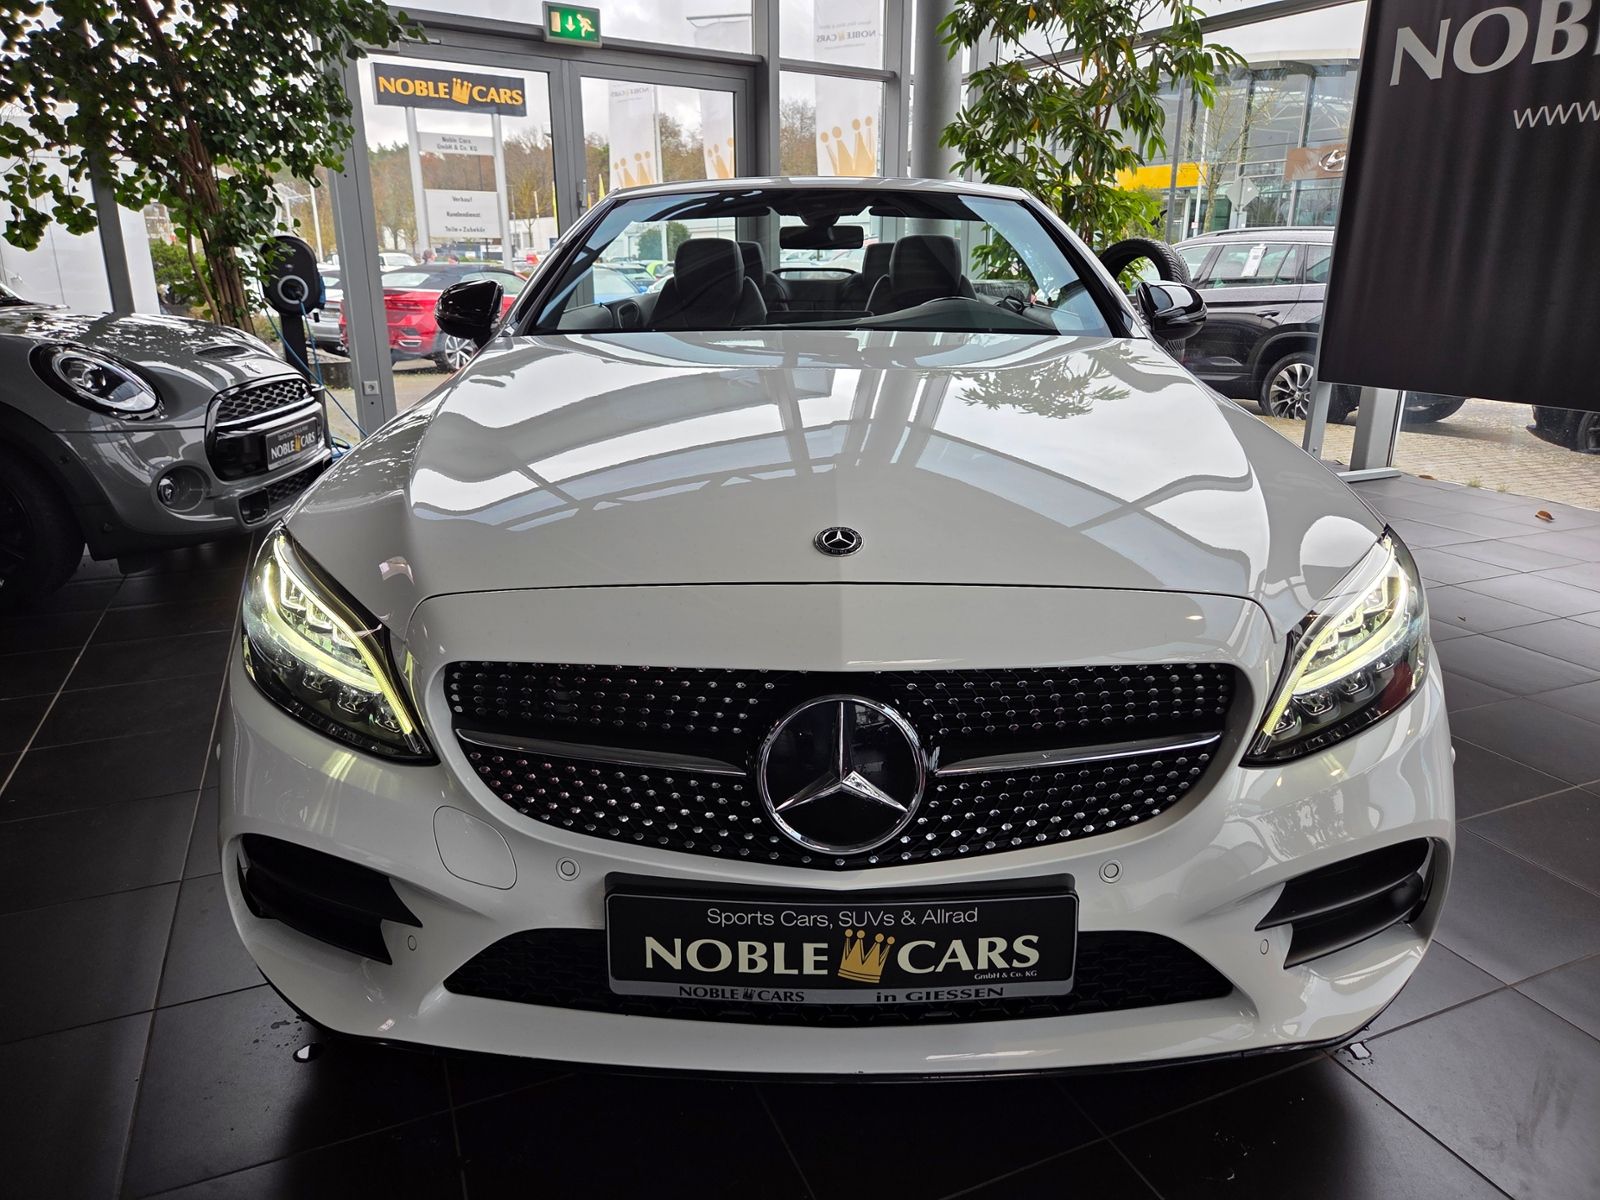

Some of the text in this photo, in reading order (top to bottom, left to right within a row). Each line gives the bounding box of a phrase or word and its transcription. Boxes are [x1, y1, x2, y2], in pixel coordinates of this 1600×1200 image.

[1390, 0, 1600, 86] NOB
[378, 76, 523, 105] NOBLE CARS
[271, 440, 295, 460] NOBLE
[301, 431, 315, 448] CARS
[707, 907, 978, 929] Sports Cars, SUVs & Allrad
[645, 934, 1040, 976] NOBLE CARS
[974, 972, 1000, 980] GmbH
[679, 985, 1004, 1002] NOBLE CARS in GIESSEN
